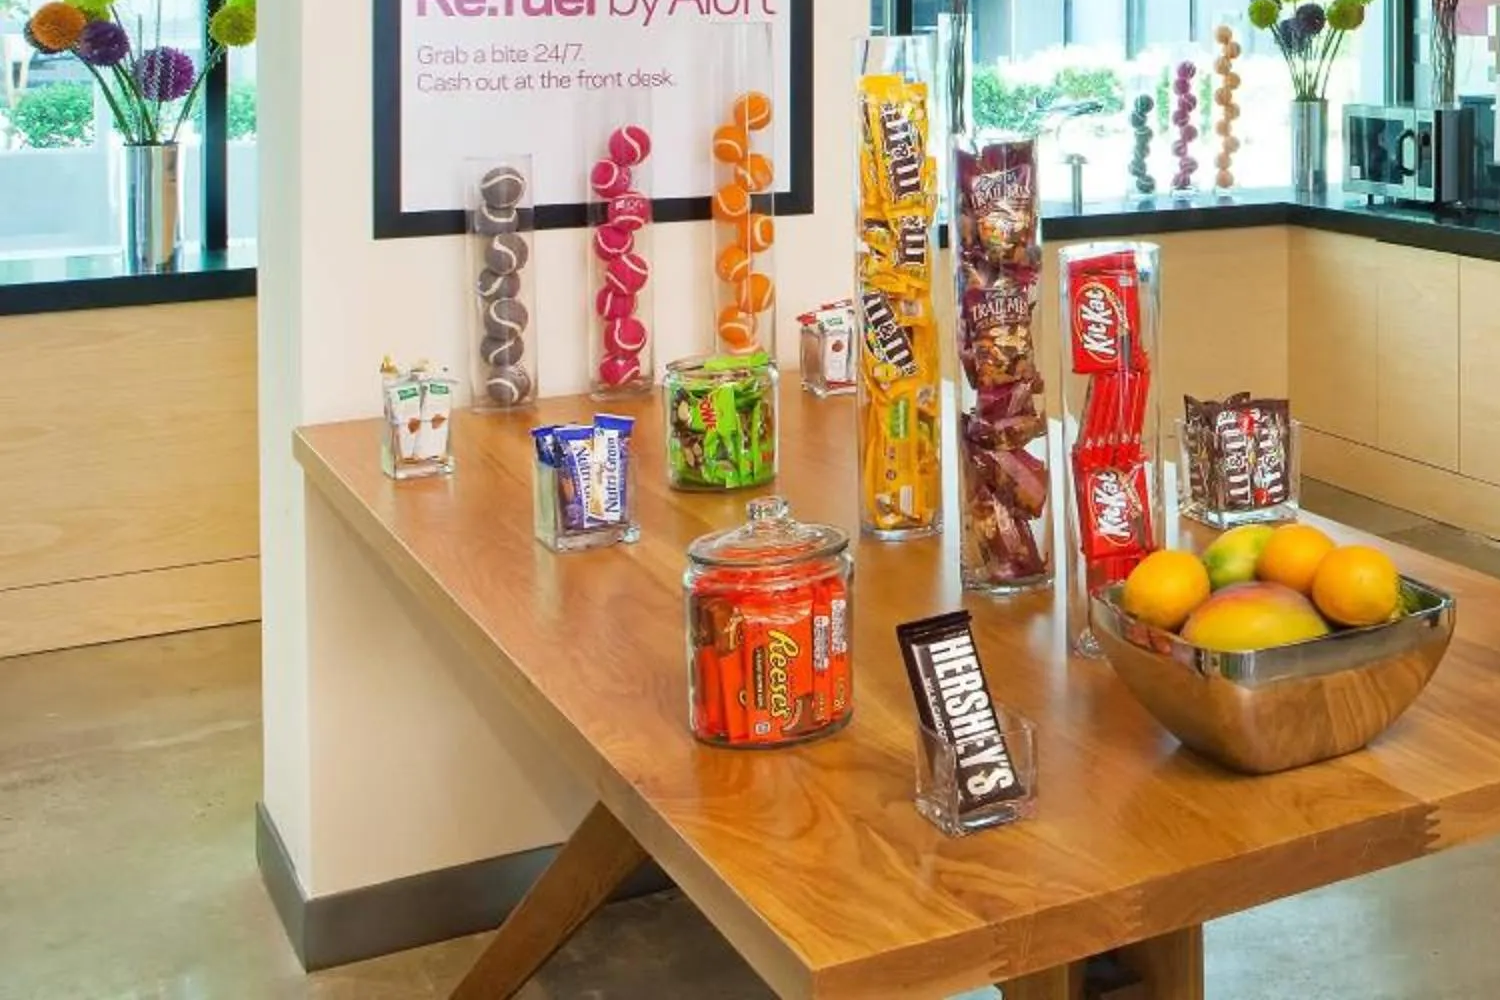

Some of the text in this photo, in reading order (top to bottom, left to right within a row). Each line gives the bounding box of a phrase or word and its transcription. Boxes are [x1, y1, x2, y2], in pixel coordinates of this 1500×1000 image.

[416, 42, 586, 65] Grab a bite 24/7.
[416, 68, 678, 93] Cash out at the front desk.
